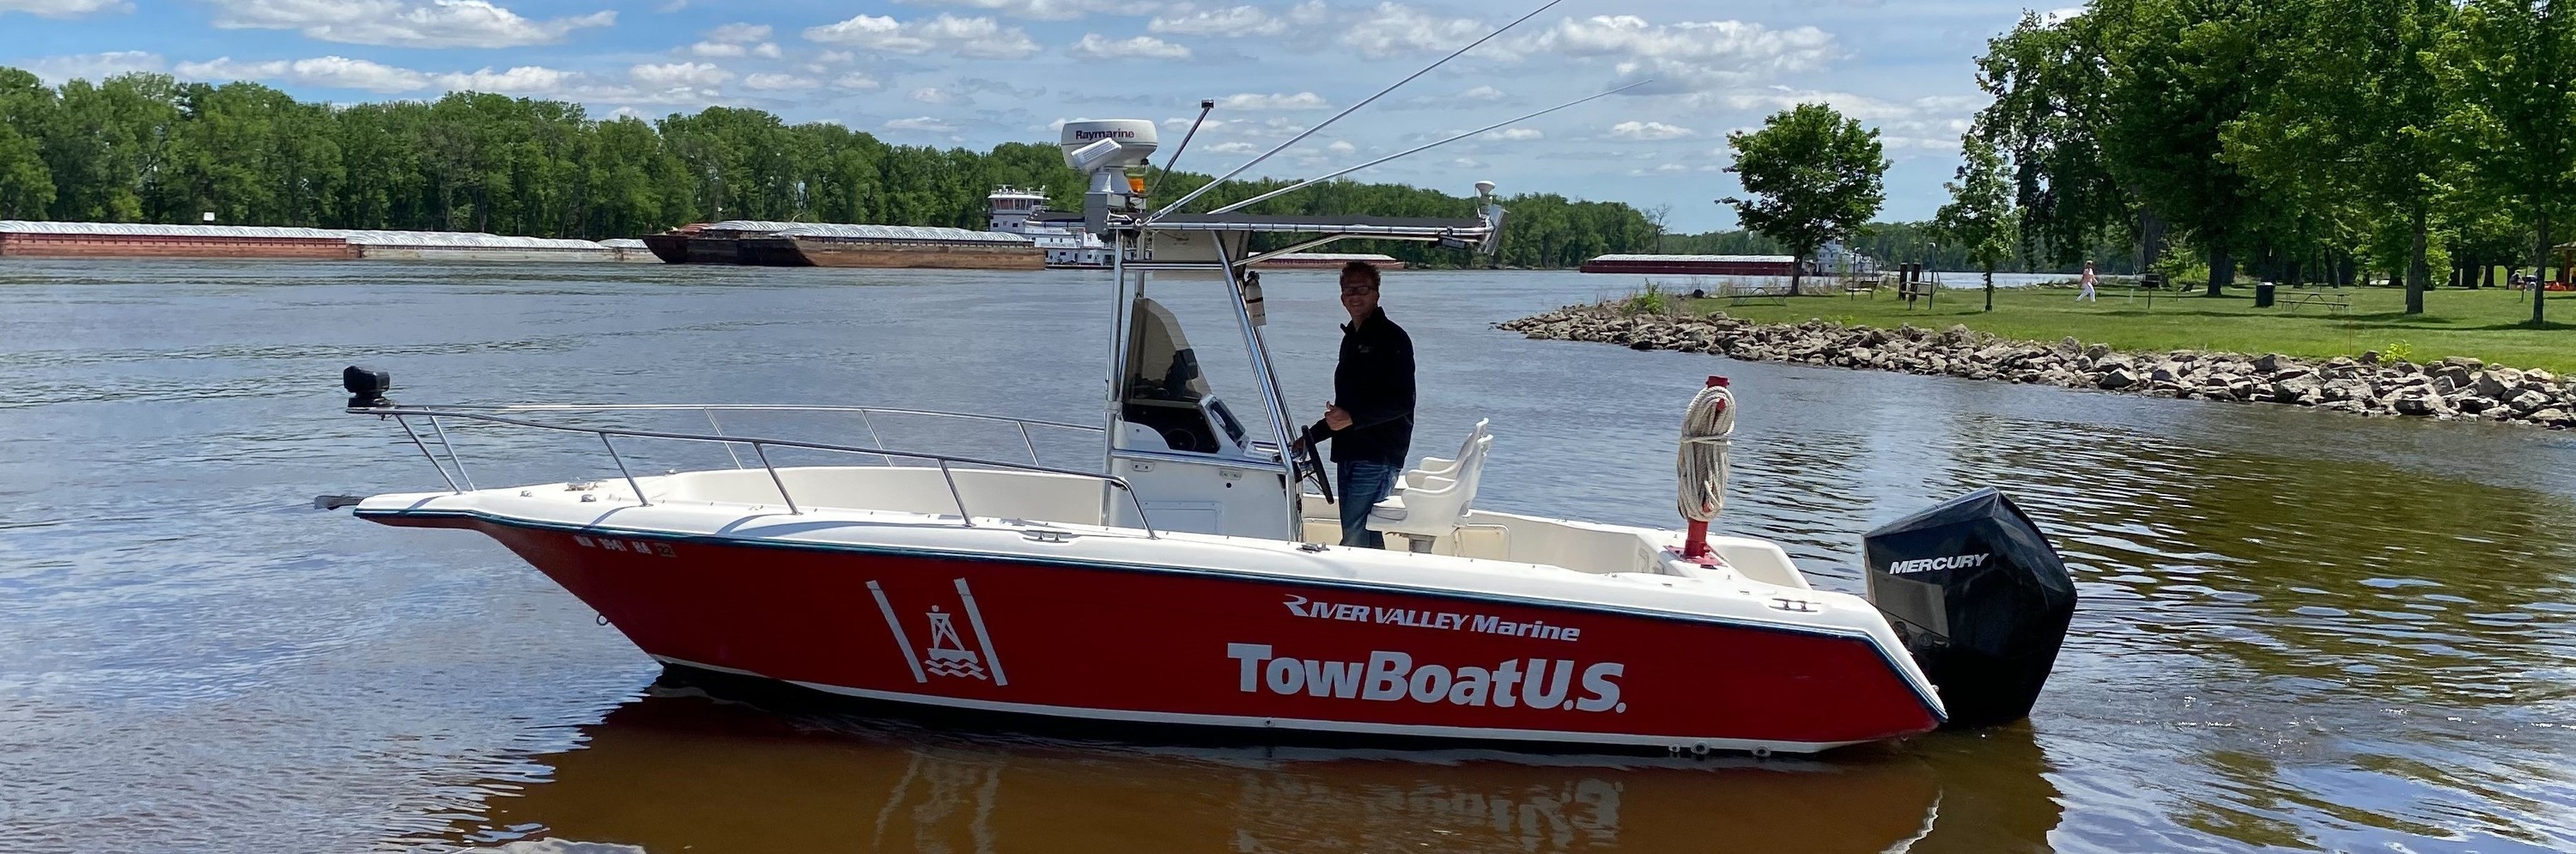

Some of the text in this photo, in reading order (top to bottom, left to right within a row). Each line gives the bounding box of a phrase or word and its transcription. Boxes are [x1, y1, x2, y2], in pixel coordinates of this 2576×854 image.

[1075, 128, 1134, 140] Raymarine
[1889, 552, 1990, 575] MERCURY
[1283, 594, 1581, 642] RIVER VALLEY Marine
[1227, 642, 1627, 714] TowBoatU.S.
